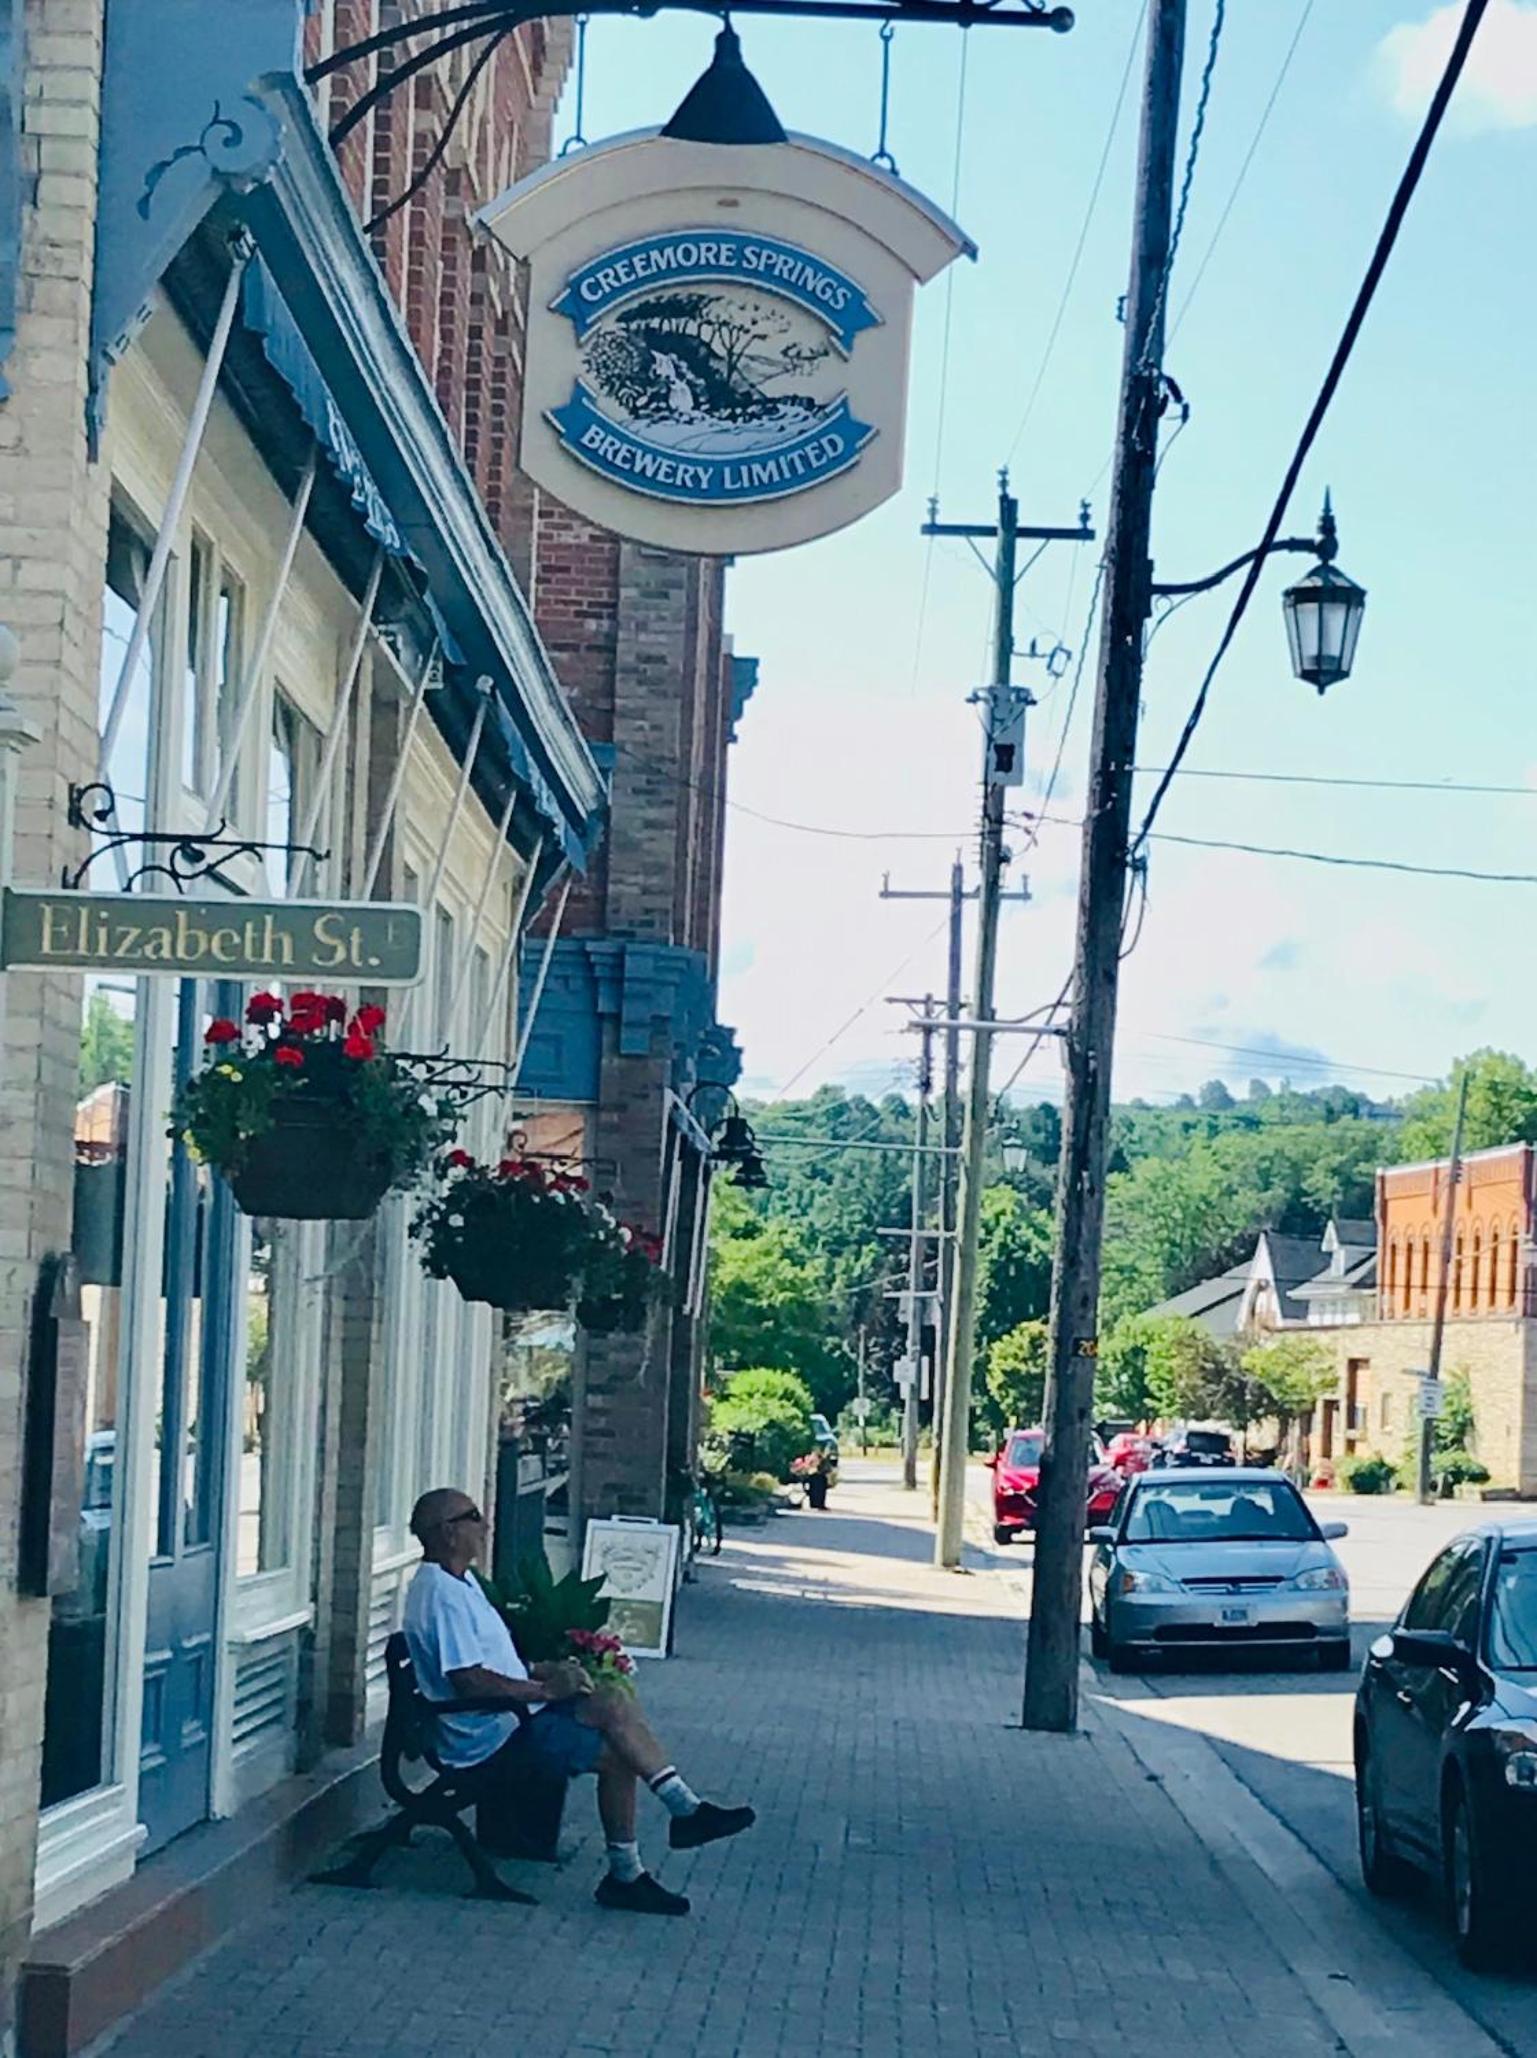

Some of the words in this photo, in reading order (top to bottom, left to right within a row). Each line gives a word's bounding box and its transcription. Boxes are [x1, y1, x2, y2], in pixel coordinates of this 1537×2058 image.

[580, 243, 737, 303] CREEMORE
[742, 245, 852, 311] SPRINGS
[580, 424, 714, 490] BREWERY
[723, 431, 845, 490] LIMITED
[38, 903, 295, 965] Elizabeth
[312, 913, 381, 968] St.
